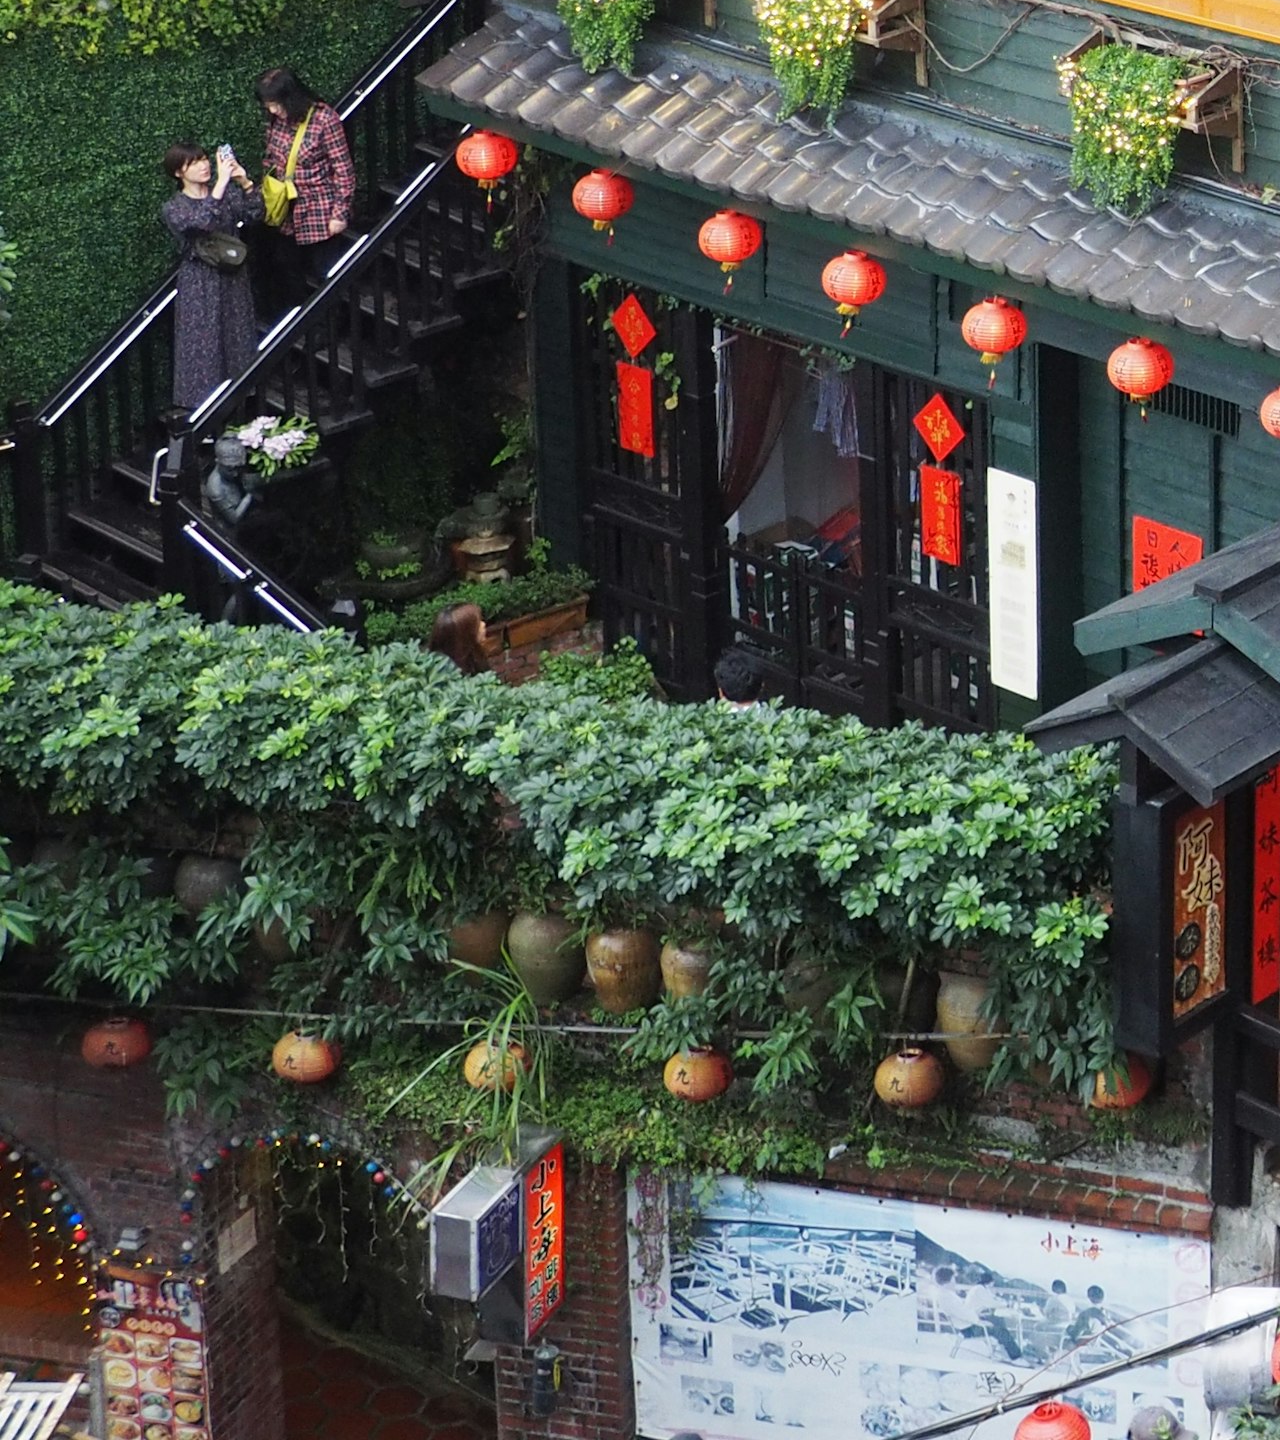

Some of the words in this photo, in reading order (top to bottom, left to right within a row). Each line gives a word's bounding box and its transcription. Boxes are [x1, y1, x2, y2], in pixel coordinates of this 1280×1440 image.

[1182, 822, 1222, 910] 阿妹
[1040, 1230, 1104, 1262] 小上海
